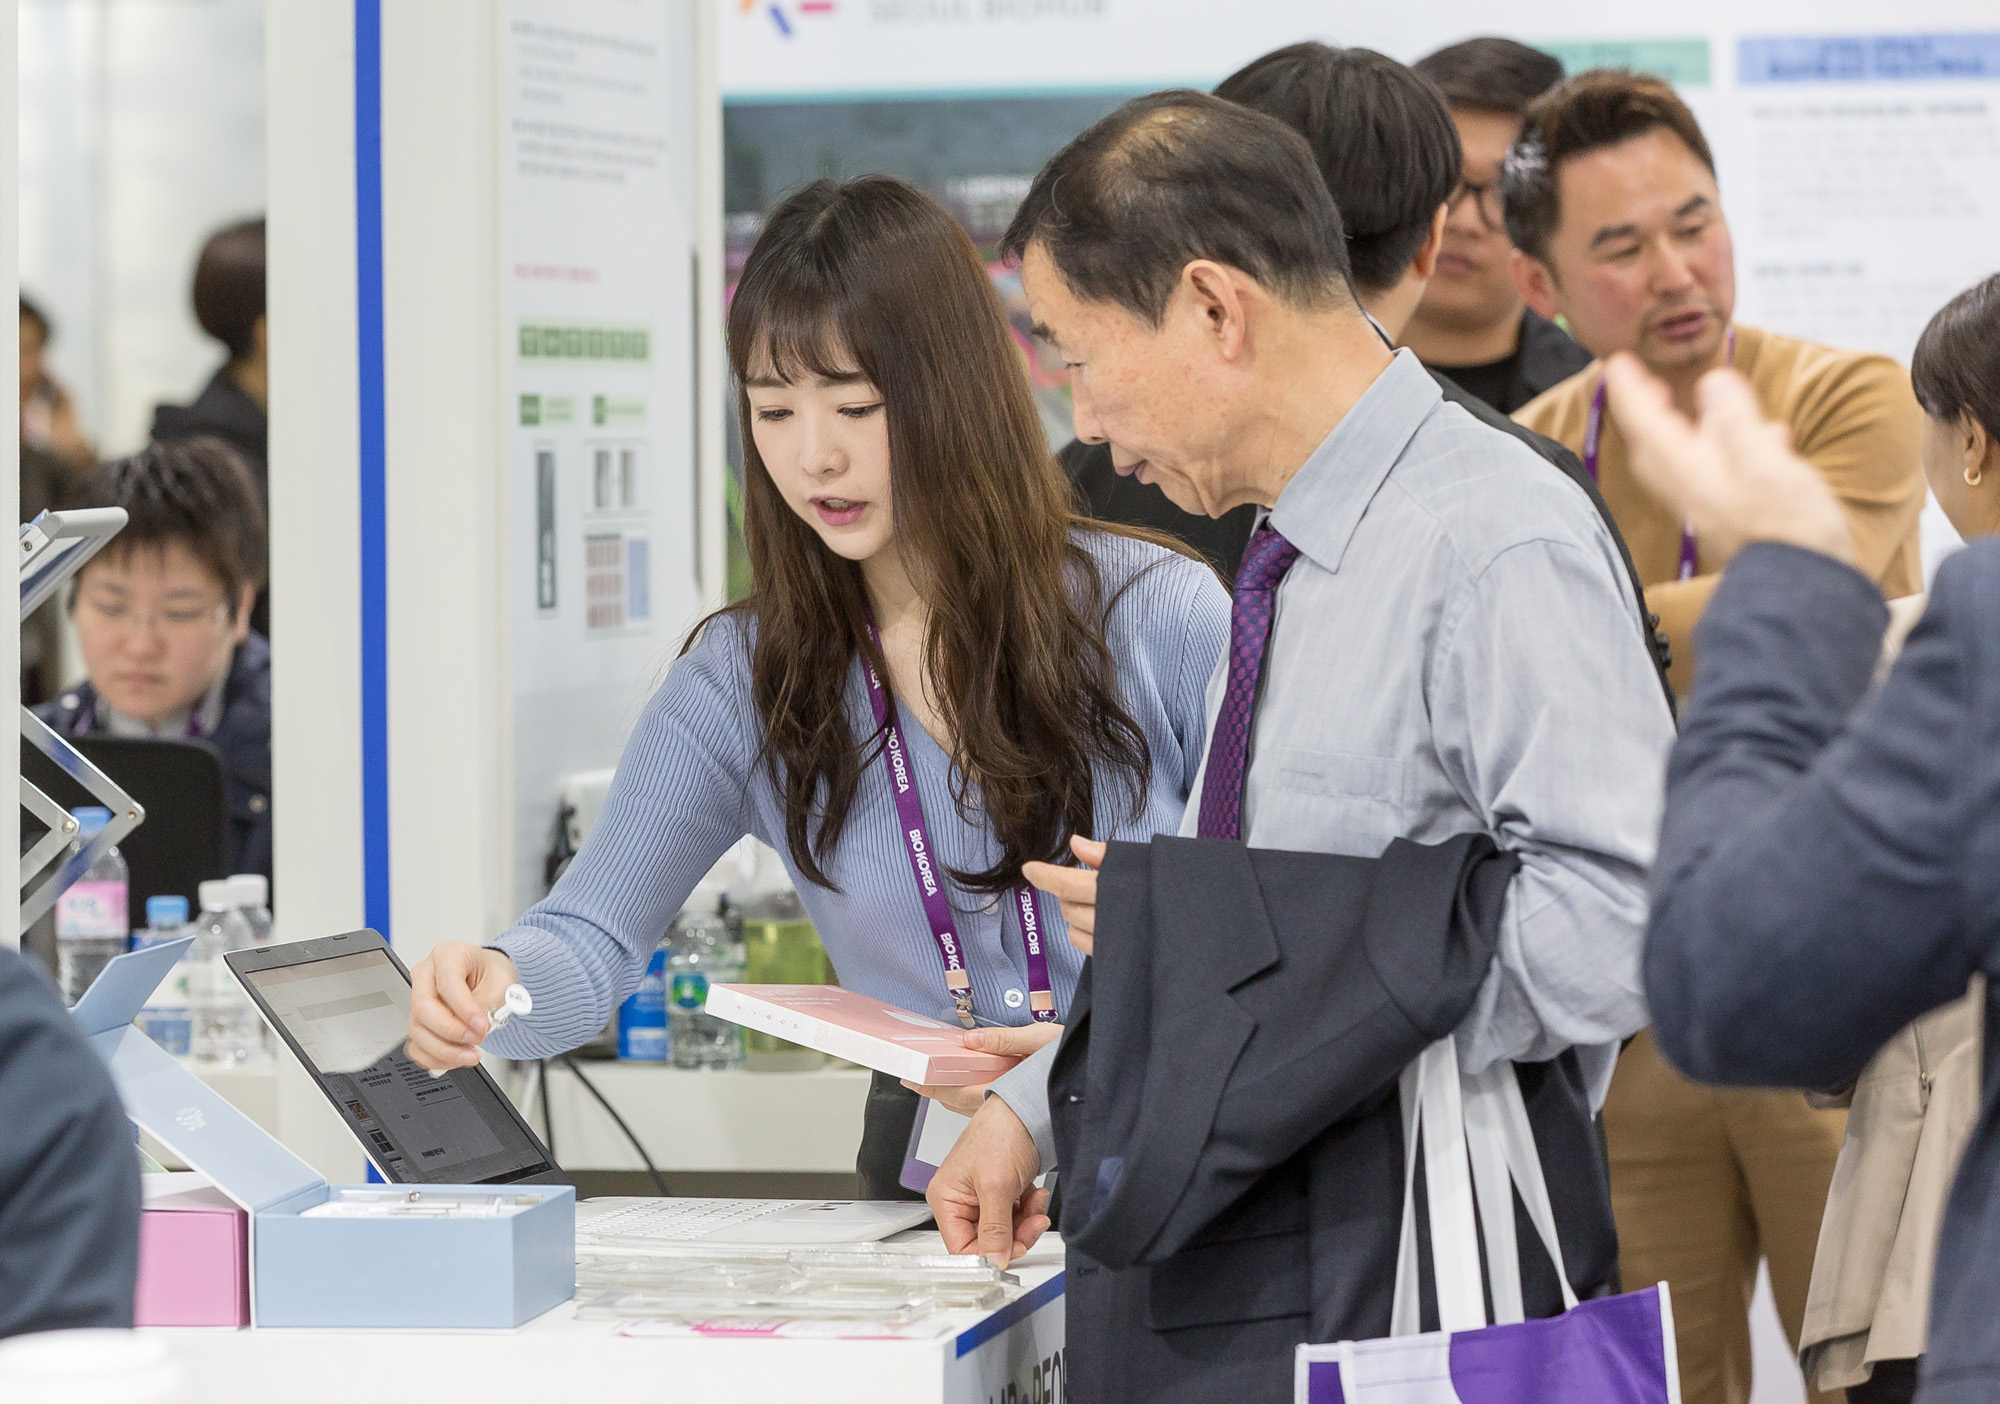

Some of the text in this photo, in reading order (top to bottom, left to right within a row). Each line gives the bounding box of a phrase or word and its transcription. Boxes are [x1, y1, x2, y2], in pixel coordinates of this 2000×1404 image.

[890, 749, 909, 794] KOREA
[909, 829, 938, 897] BIO KOREA
[940, 932, 956, 954] BIO
[1027, 932, 1040, 955] BIO
